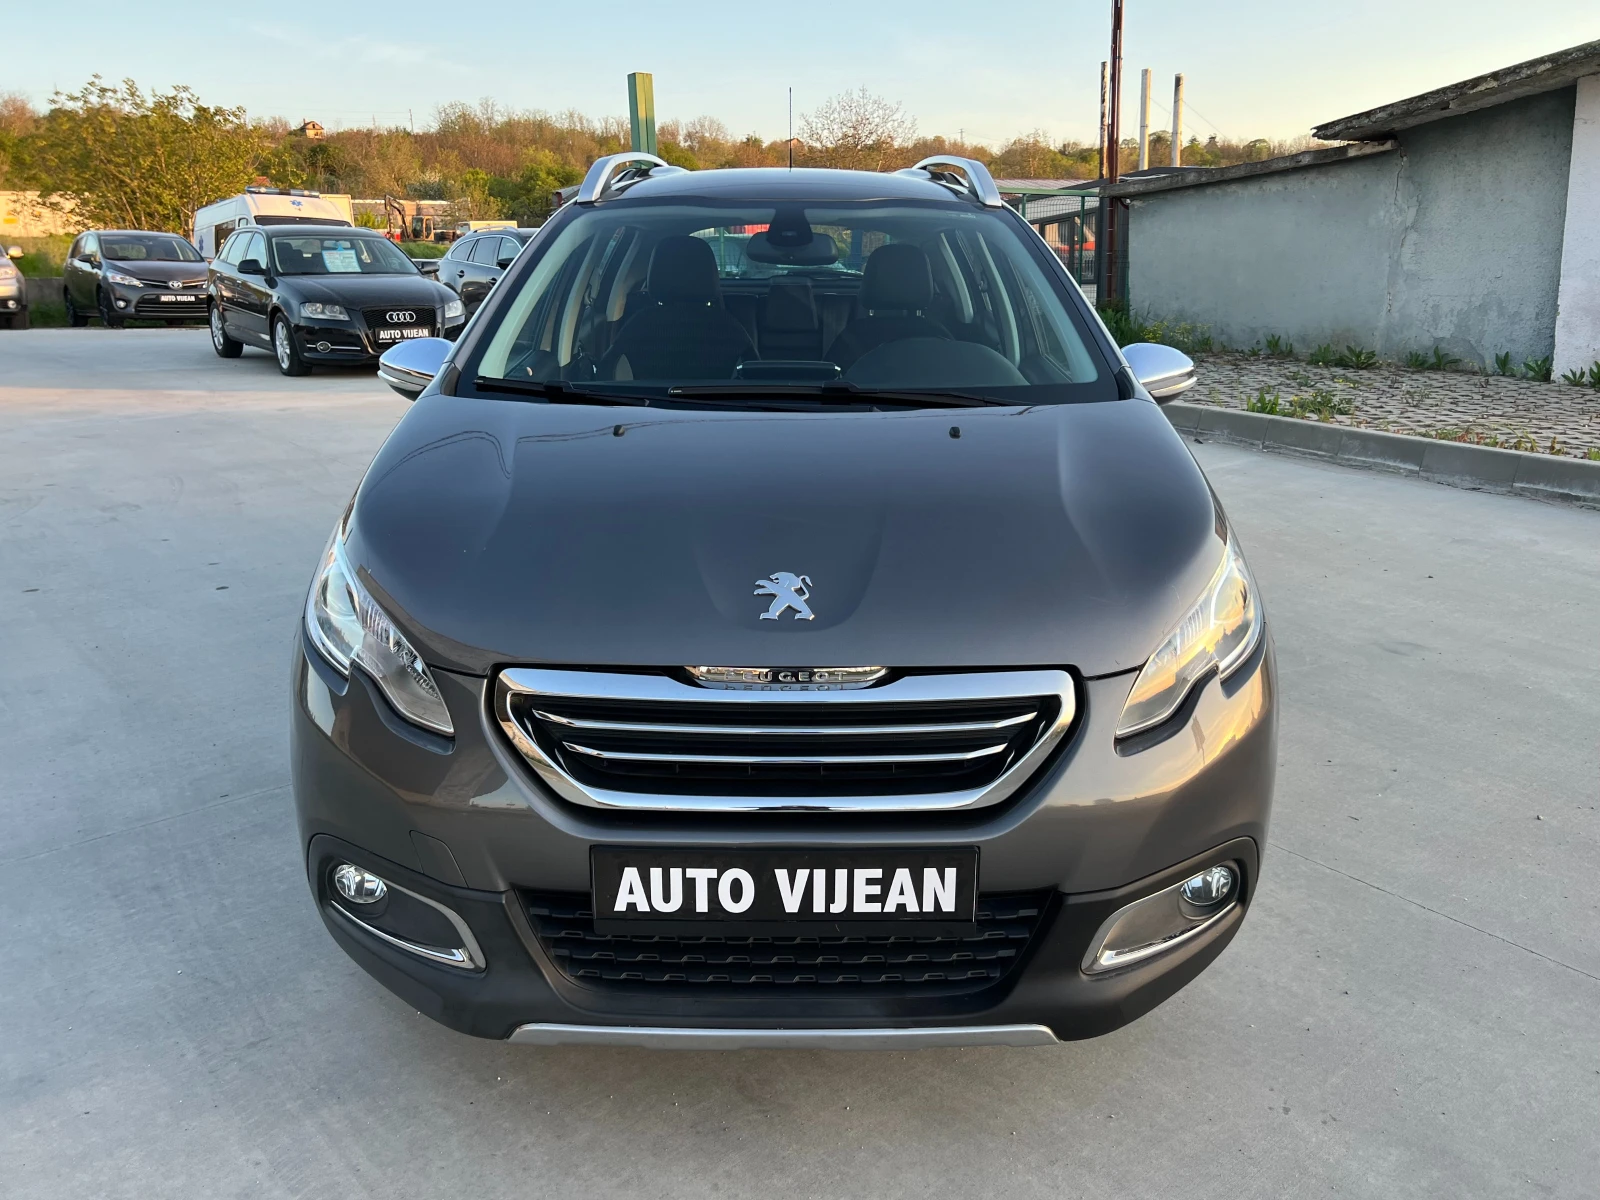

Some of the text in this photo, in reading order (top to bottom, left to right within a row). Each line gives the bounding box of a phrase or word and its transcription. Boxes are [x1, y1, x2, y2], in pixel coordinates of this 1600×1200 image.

[380, 329, 429, 339] AUTO VIJEAN
[724, 670, 848, 682] PEUGEOT
[613, 866, 957, 914] AUTO VIJEAN
